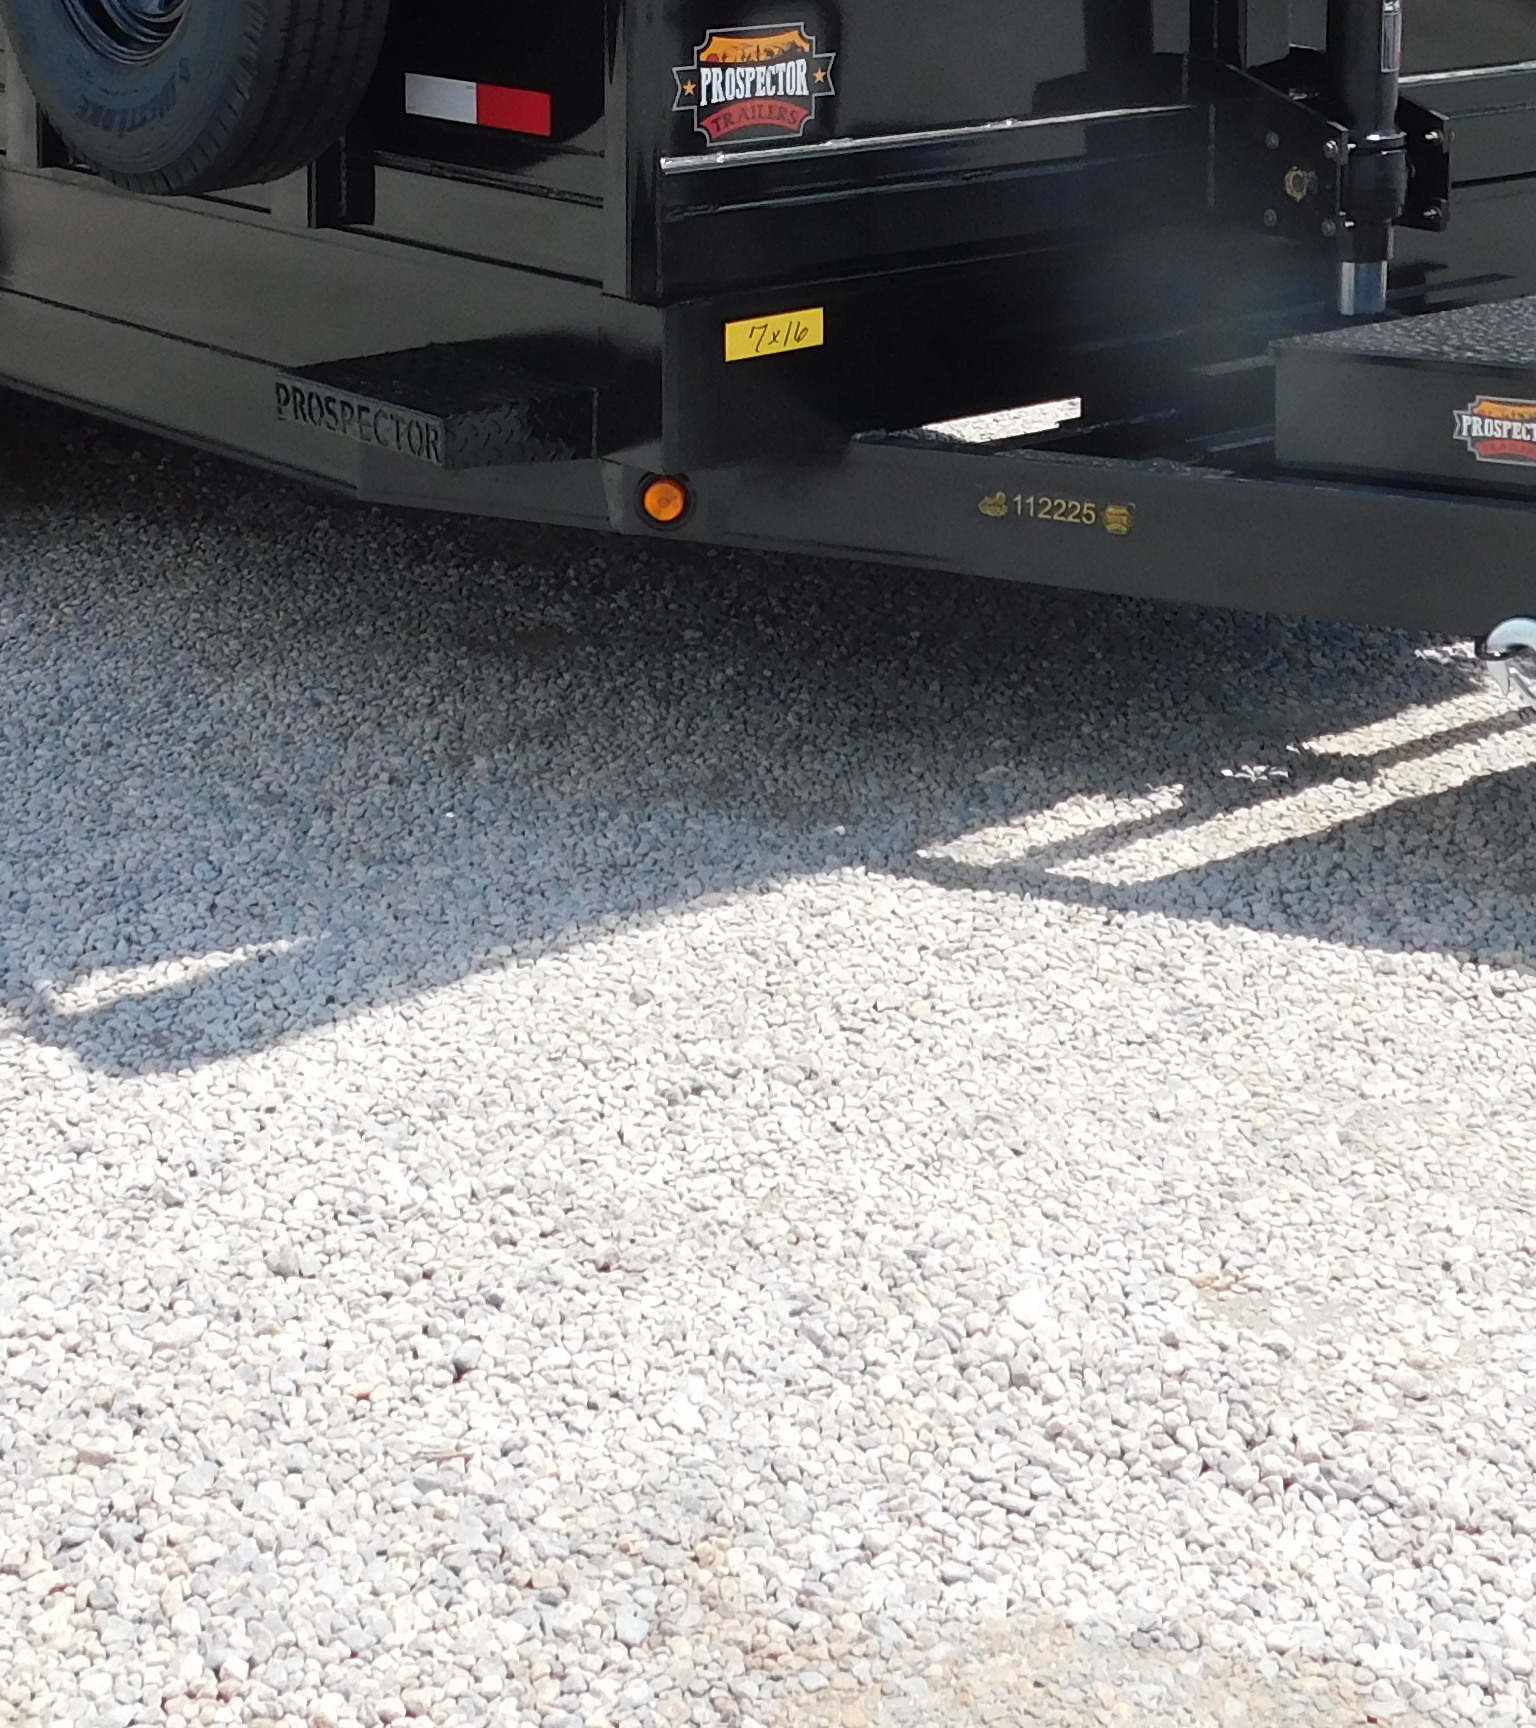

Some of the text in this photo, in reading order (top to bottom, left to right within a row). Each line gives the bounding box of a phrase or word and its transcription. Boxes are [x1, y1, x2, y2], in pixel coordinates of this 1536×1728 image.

[700, 58, 809, 107] PROSPECTOR
[710, 102, 800, 133] TRAILERS
[275, 381, 442, 464] PROSPECTOR
[1013, 493, 1096, 525] 112225
